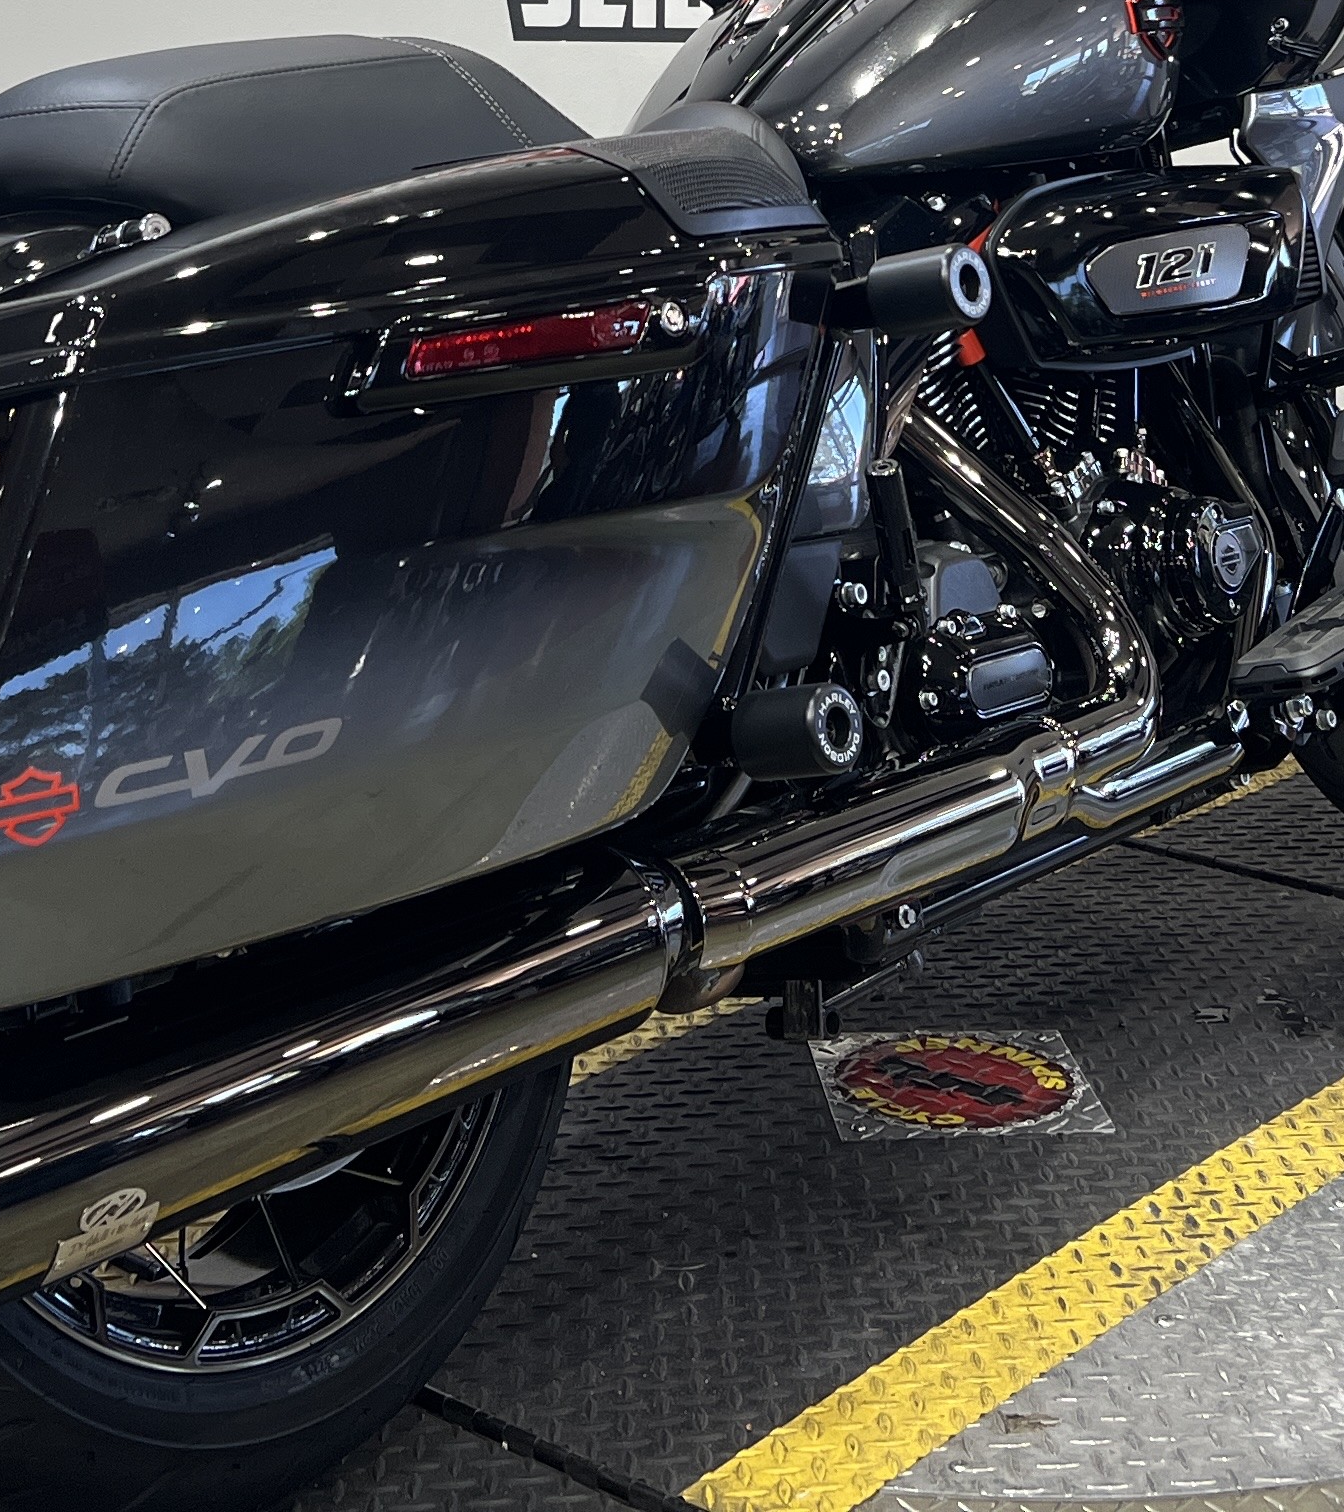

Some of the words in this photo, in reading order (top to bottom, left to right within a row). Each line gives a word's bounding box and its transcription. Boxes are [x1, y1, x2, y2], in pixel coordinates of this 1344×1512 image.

[1136, 242, 1217, 289] 121
[818, 693, 857, 717] HARLEY
[94, 717, 343, 808] CVO
[818, 732, 861, 763] DAVIDSON
